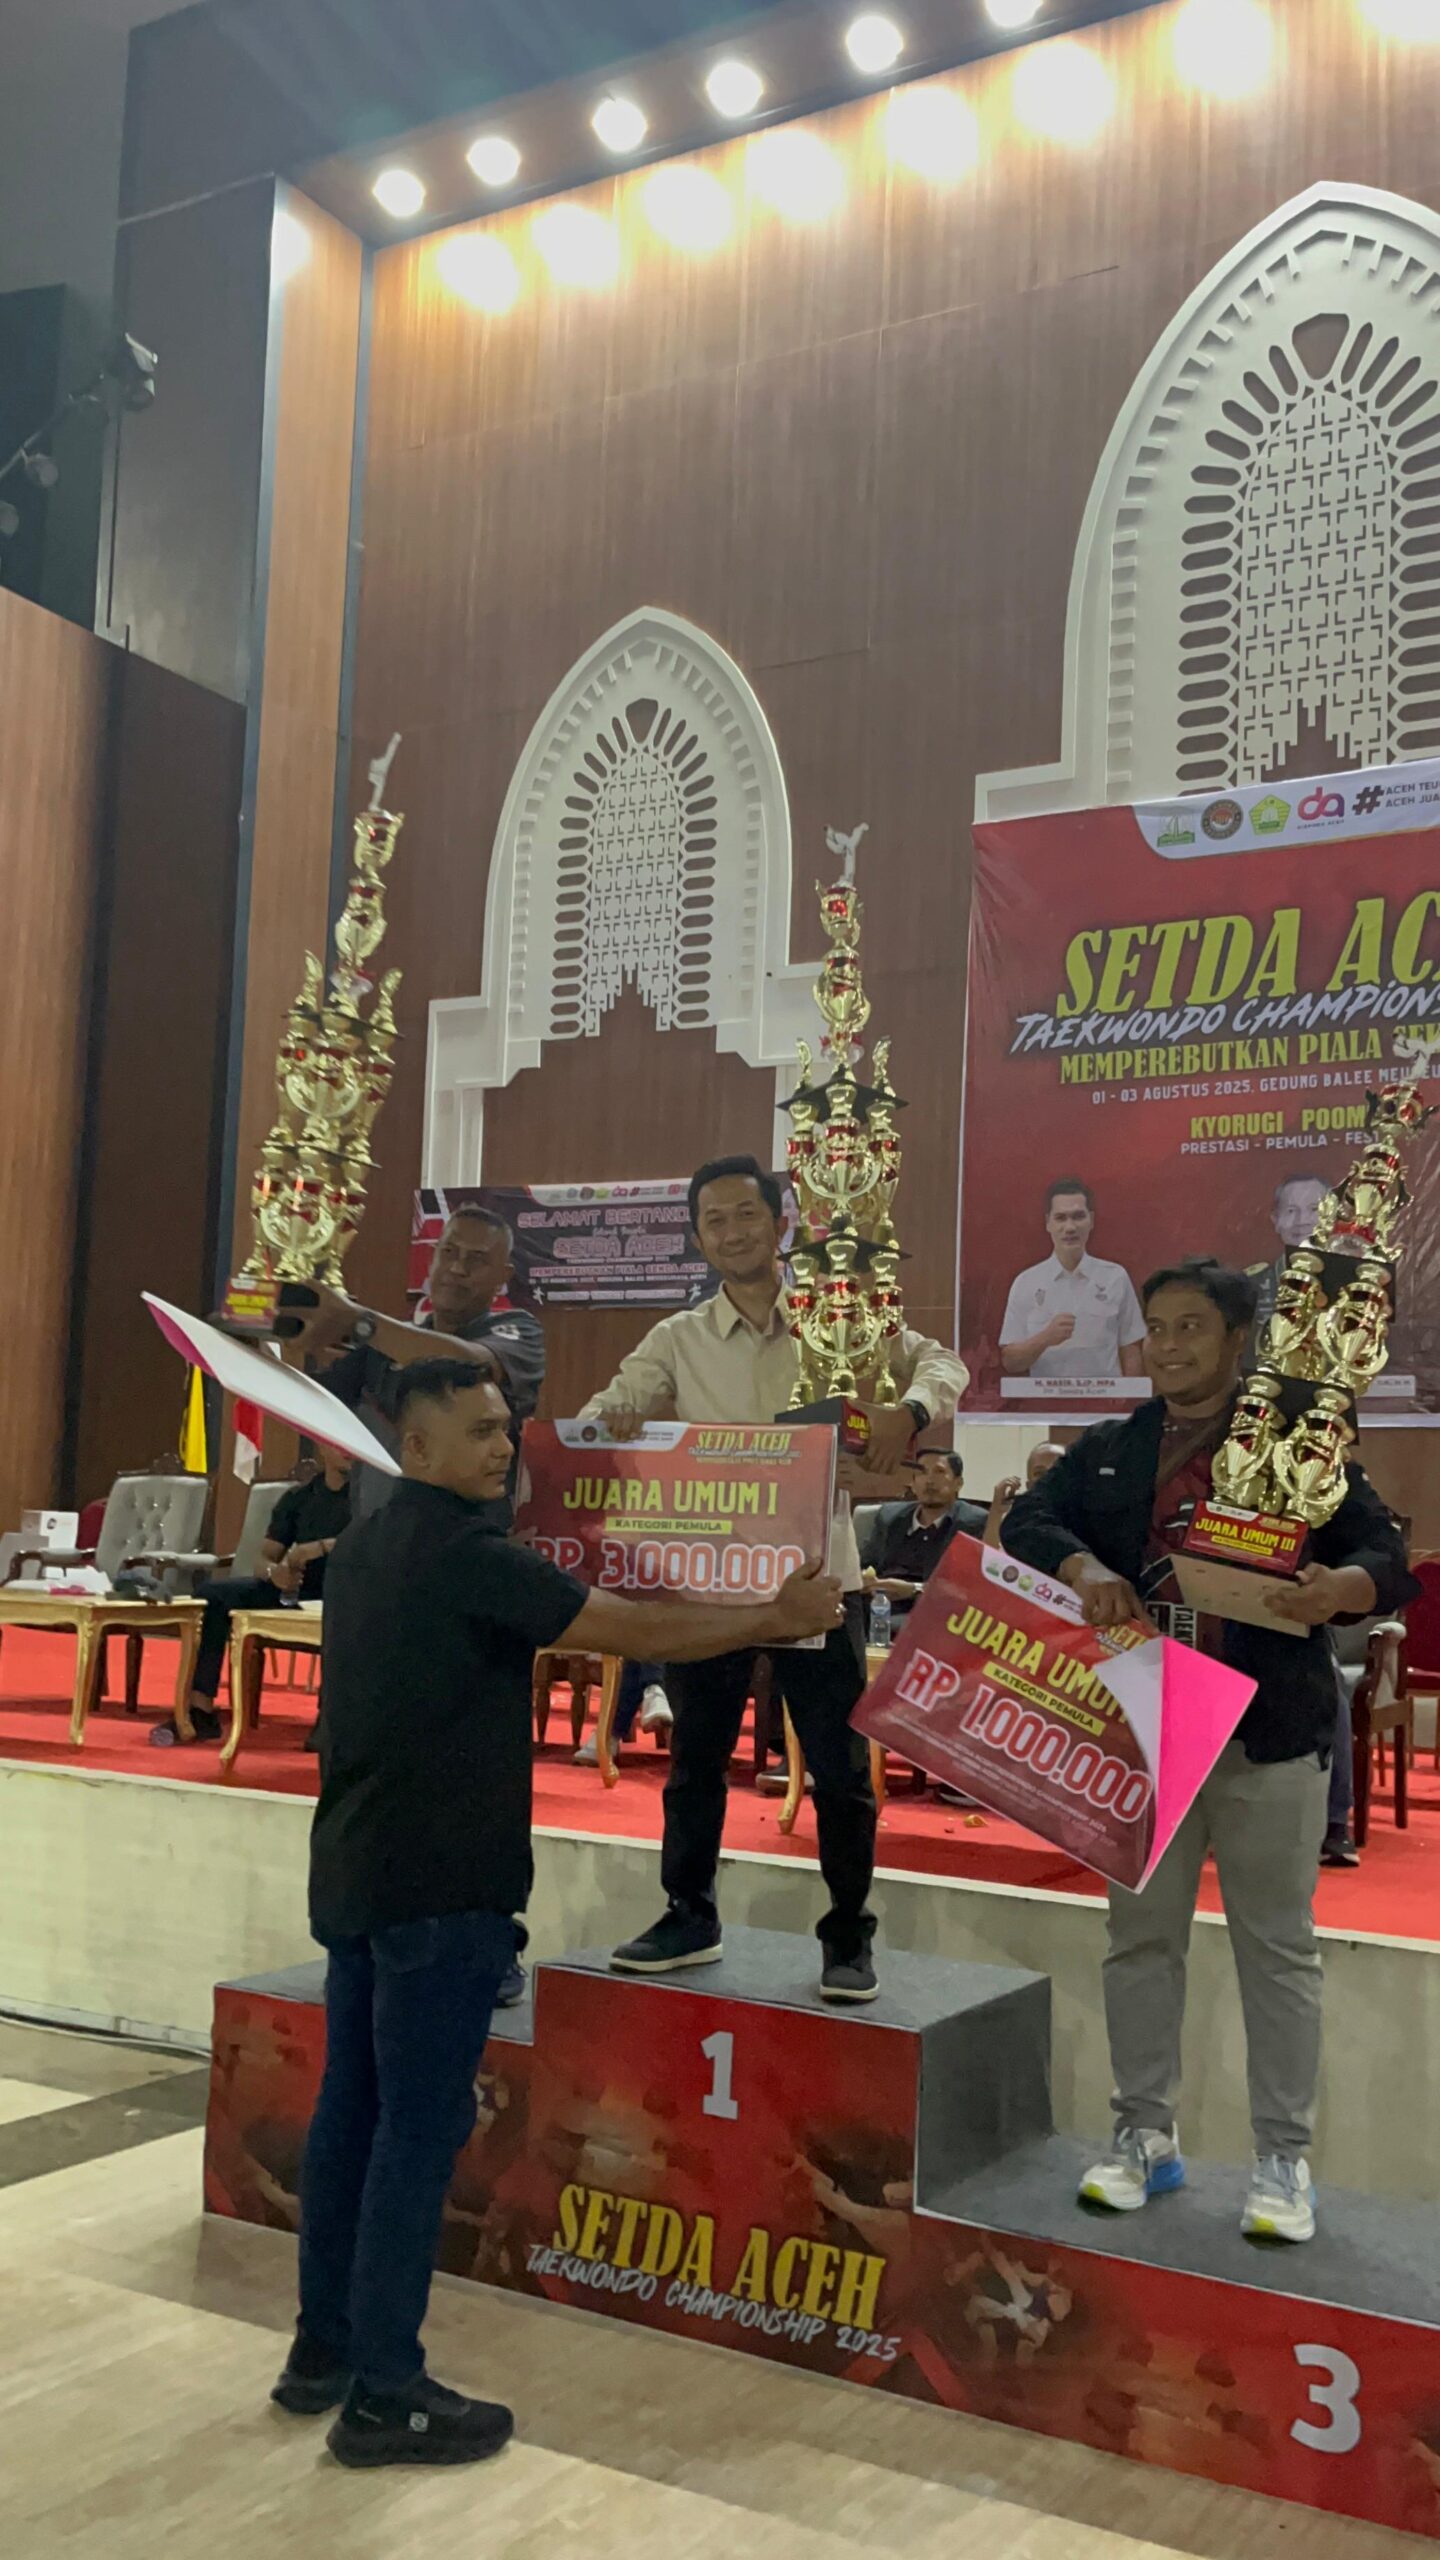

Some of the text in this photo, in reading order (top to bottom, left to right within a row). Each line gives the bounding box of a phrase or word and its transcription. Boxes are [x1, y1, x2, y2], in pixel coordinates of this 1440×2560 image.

[1385, 796, 1415, 808] ACEH
[1386, 783, 1415, 795] ACEH
[1056, 890, 1440, 1018] SETDA AC
[1009, 1005, 1227, 1054] TAEKWONDO
[1060, 1037, 1290, 1085] MEMPEREBUTKAN
[1299, 1028, 1383, 1066] PIALA
[1120, 1091, 1137, 1103] 03
[1143, 1083, 1209, 1101] AGUSTUS
[1260, 1074, 1318, 1092] GEDUNG
[1323, 1069, 1373, 1086] BALEE
[1180, 1139, 1250, 1155] PRESTASI
[1265, 1134, 1328, 1151] PEMULA
[1190, 1111, 1284, 1139] KYORUGI
[517, 1209, 601, 1229] SELAMAT
[553, 1233, 686, 1259] SETDA ACEH
[696, 1431, 745, 1450] SETDA
[750, 1431, 793, 1451] ACEH
[563, 1477, 779, 1516] JUARA UMUM I
[615, 1519, 722, 1532] KATEGORI PEMULA
[1195, 1518, 1239, 1538] JUARA
[1241, 1528, 1280, 1548] UMUM
[1280, 1537, 1296, 1551] III
[598, 1539, 806, 1594] 3.000.000
[946, 1605, 1046, 1676] JUARA
[994, 1668, 1095, 1729] KATEGORI PEMULA
[895, 1648, 961, 1712] RP
[959, 1683, 1154, 1823] 1.000.000
[699, 2030, 739, 2121] 1
[552, 2183, 886, 2331] SETDA ACEH
[526, 2244, 902, 2362] TAEKWONDO CHAMPIONSHIP 2025
[1290, 2343, 1362, 2454] 3
